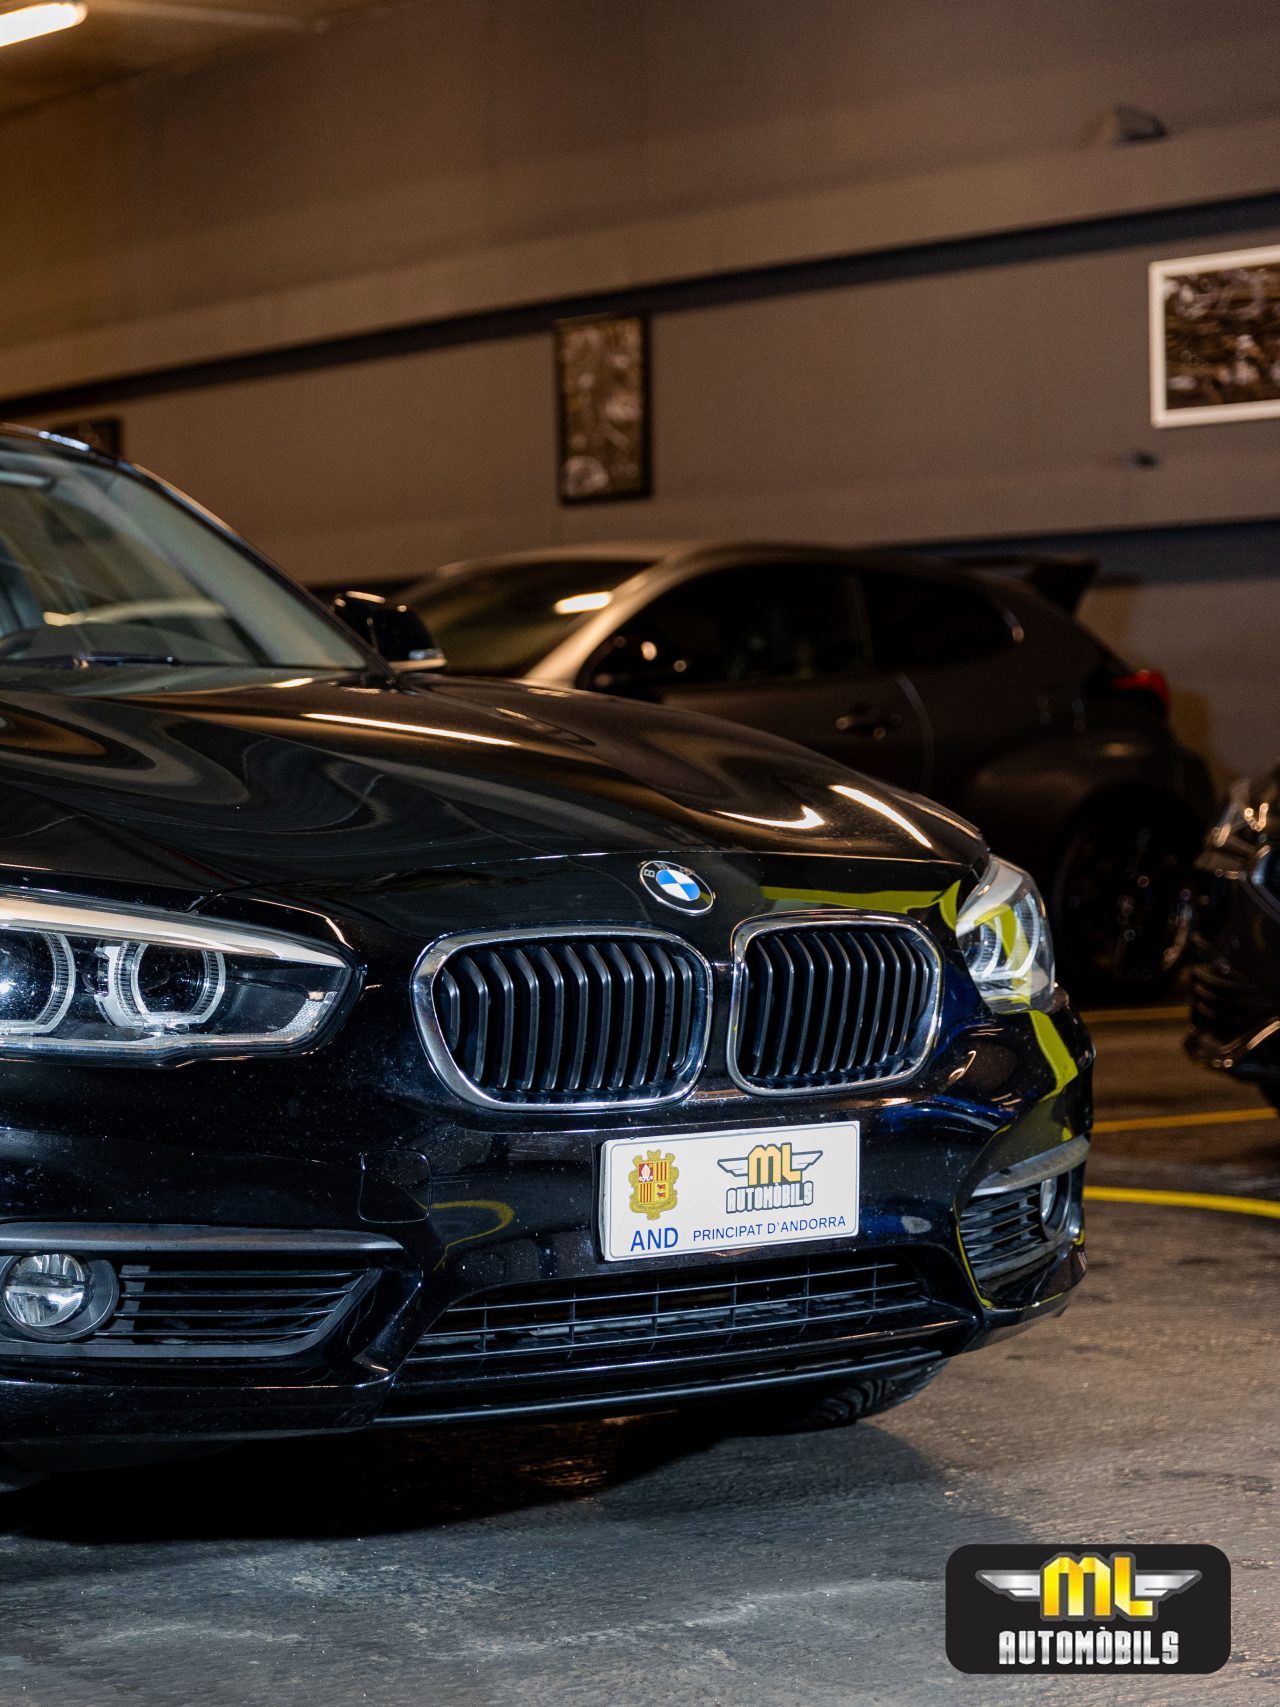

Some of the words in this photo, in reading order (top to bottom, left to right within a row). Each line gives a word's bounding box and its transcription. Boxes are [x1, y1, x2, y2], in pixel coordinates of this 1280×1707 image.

[748, 1142, 802, 1186] ML
[630, 1227, 679, 1252] AND
[693, 1224, 763, 1242] PRINCIPAT
[767, 1216, 846, 1235] D'ANDORRA
